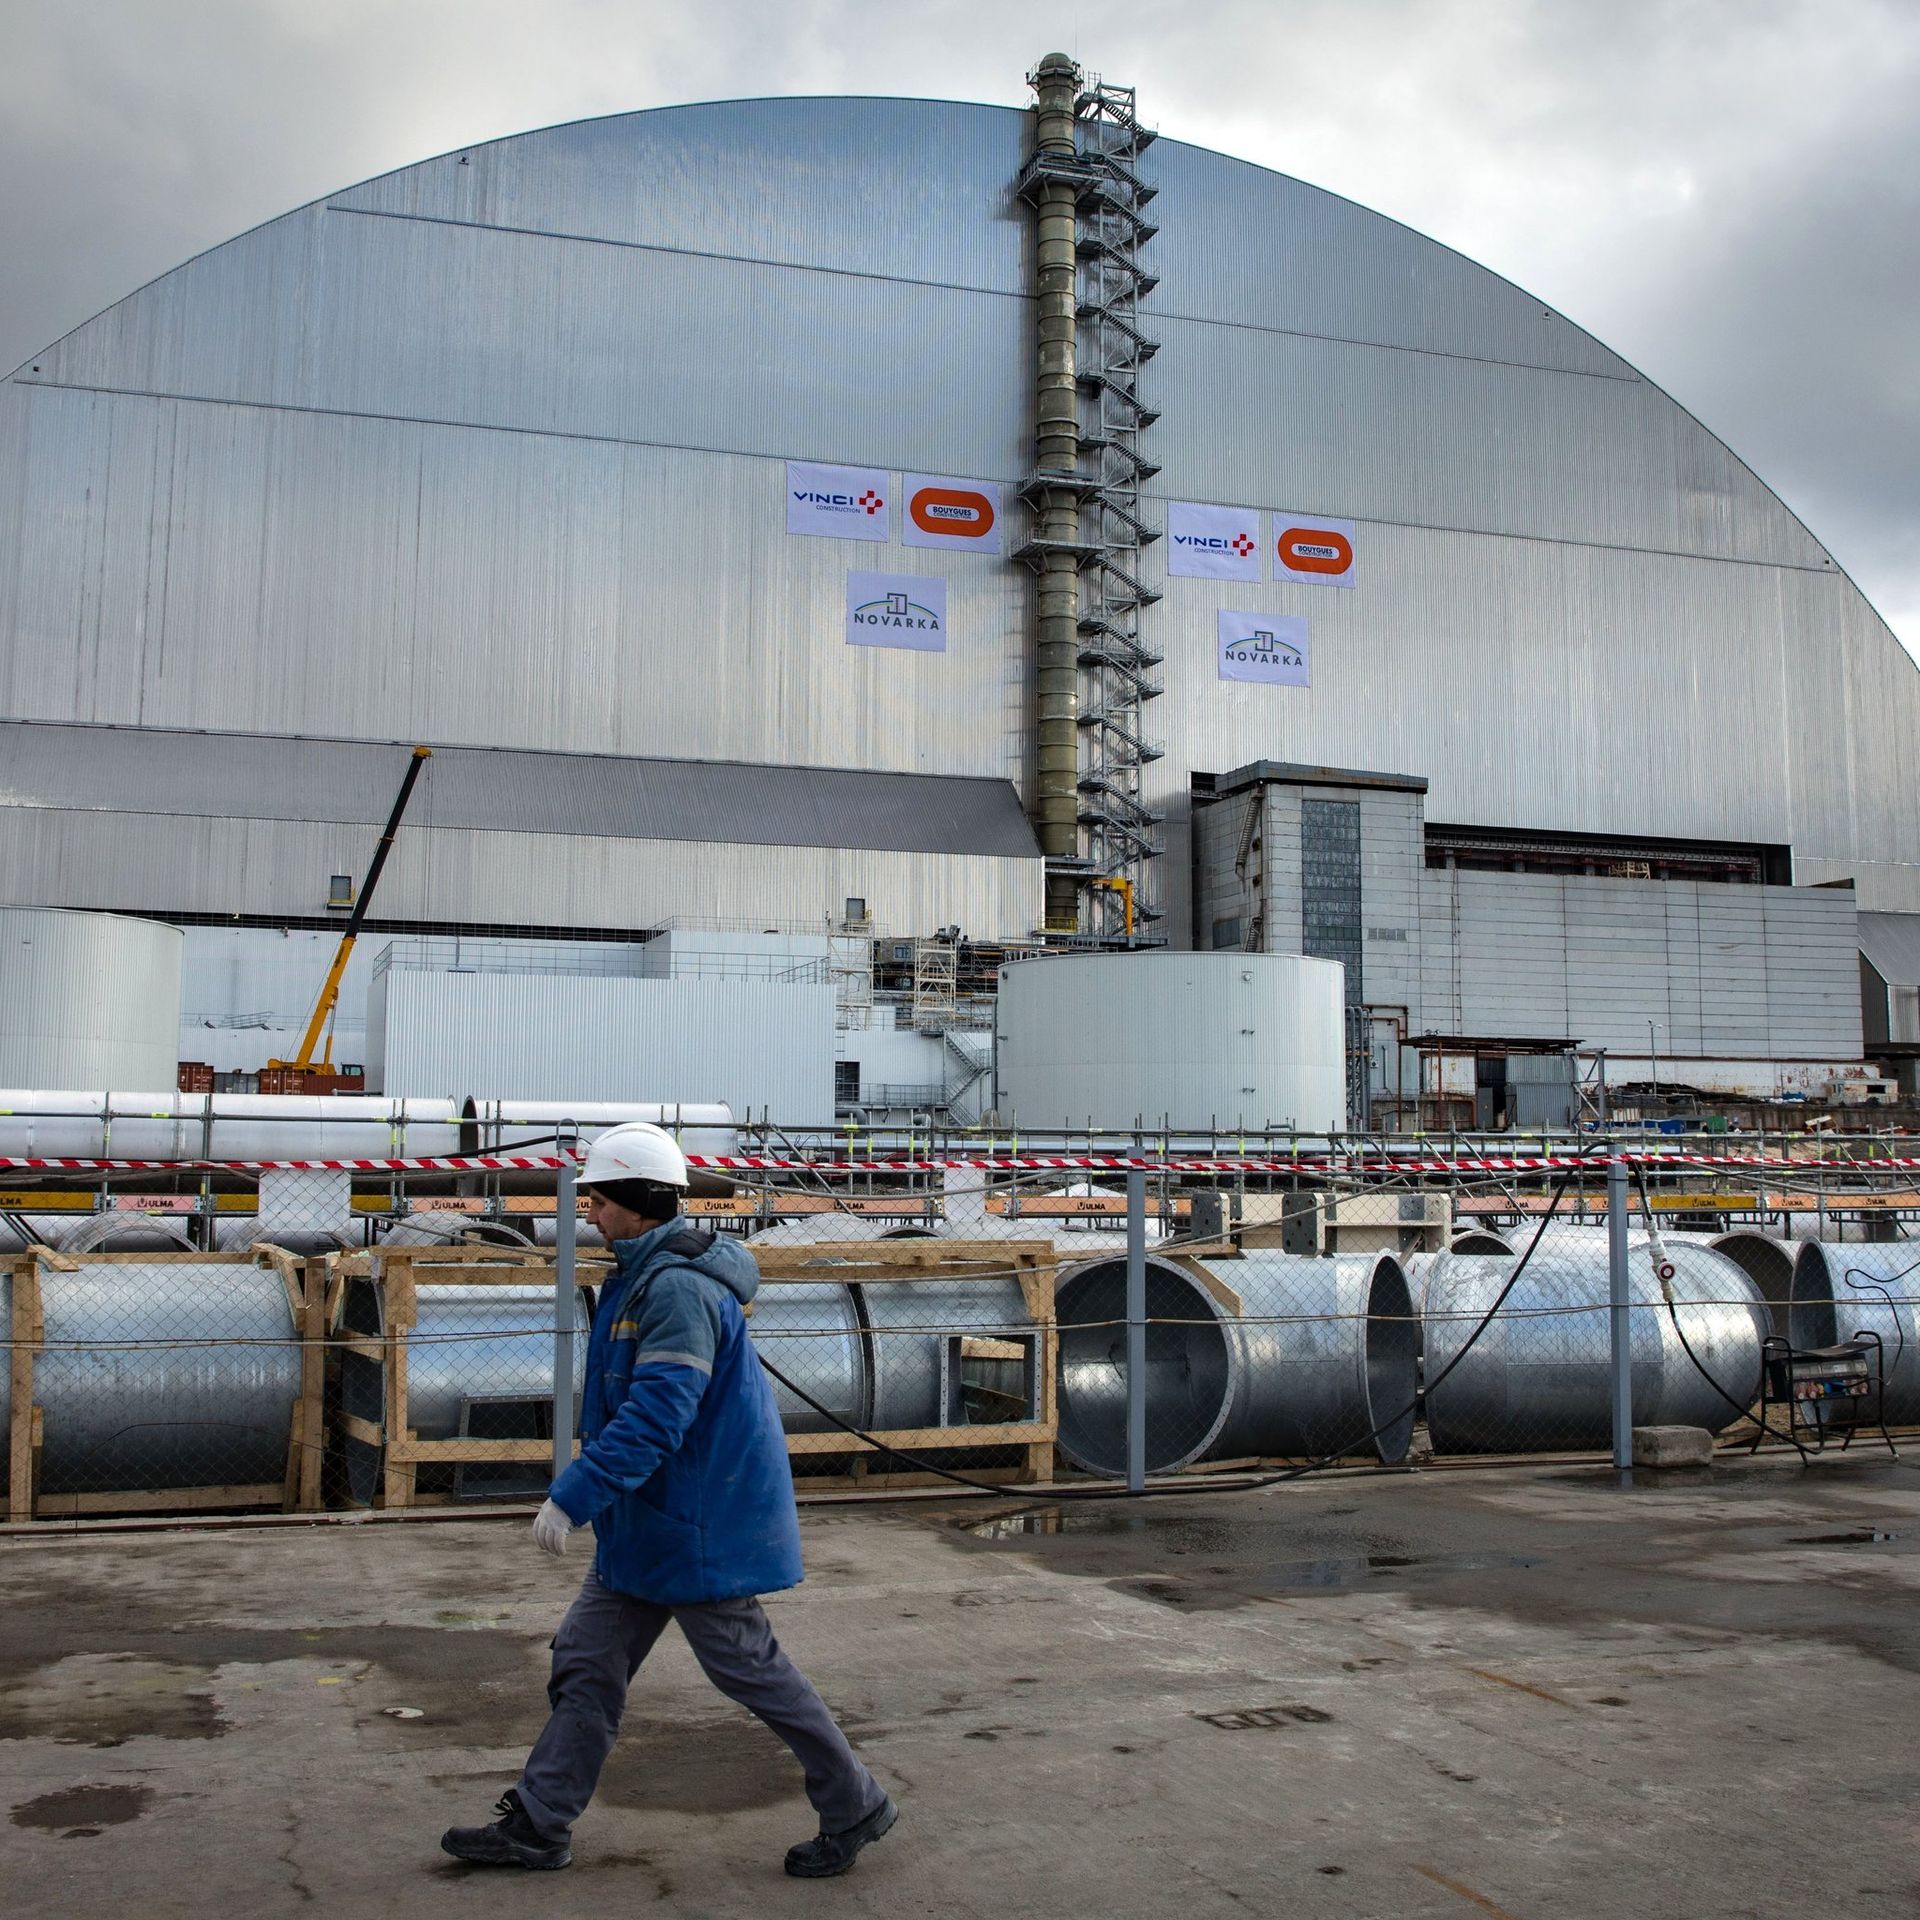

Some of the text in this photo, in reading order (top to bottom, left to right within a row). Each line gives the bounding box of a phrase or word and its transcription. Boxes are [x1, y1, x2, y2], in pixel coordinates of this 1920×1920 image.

[793, 491, 853, 505] VINCI
[816, 504, 860, 513] CONSTRUCTION
[932, 506, 972, 516] BOUYGUES
[1174, 535, 1227, 548] VINCI
[1194, 547, 1234, 556] CONSTRUCTION
[1298, 545, 1333, 554] BOUYGUES
[854, 613, 939, 630] NOVARKA
[1225, 650, 1303, 666] NOVARKA
[0, 1197, 22, 1205] LMA
[148, 1200, 174, 1208] ULMA
[580, 1201, 591, 1209] UL
[442, 1202, 467, 1210] ULMA
